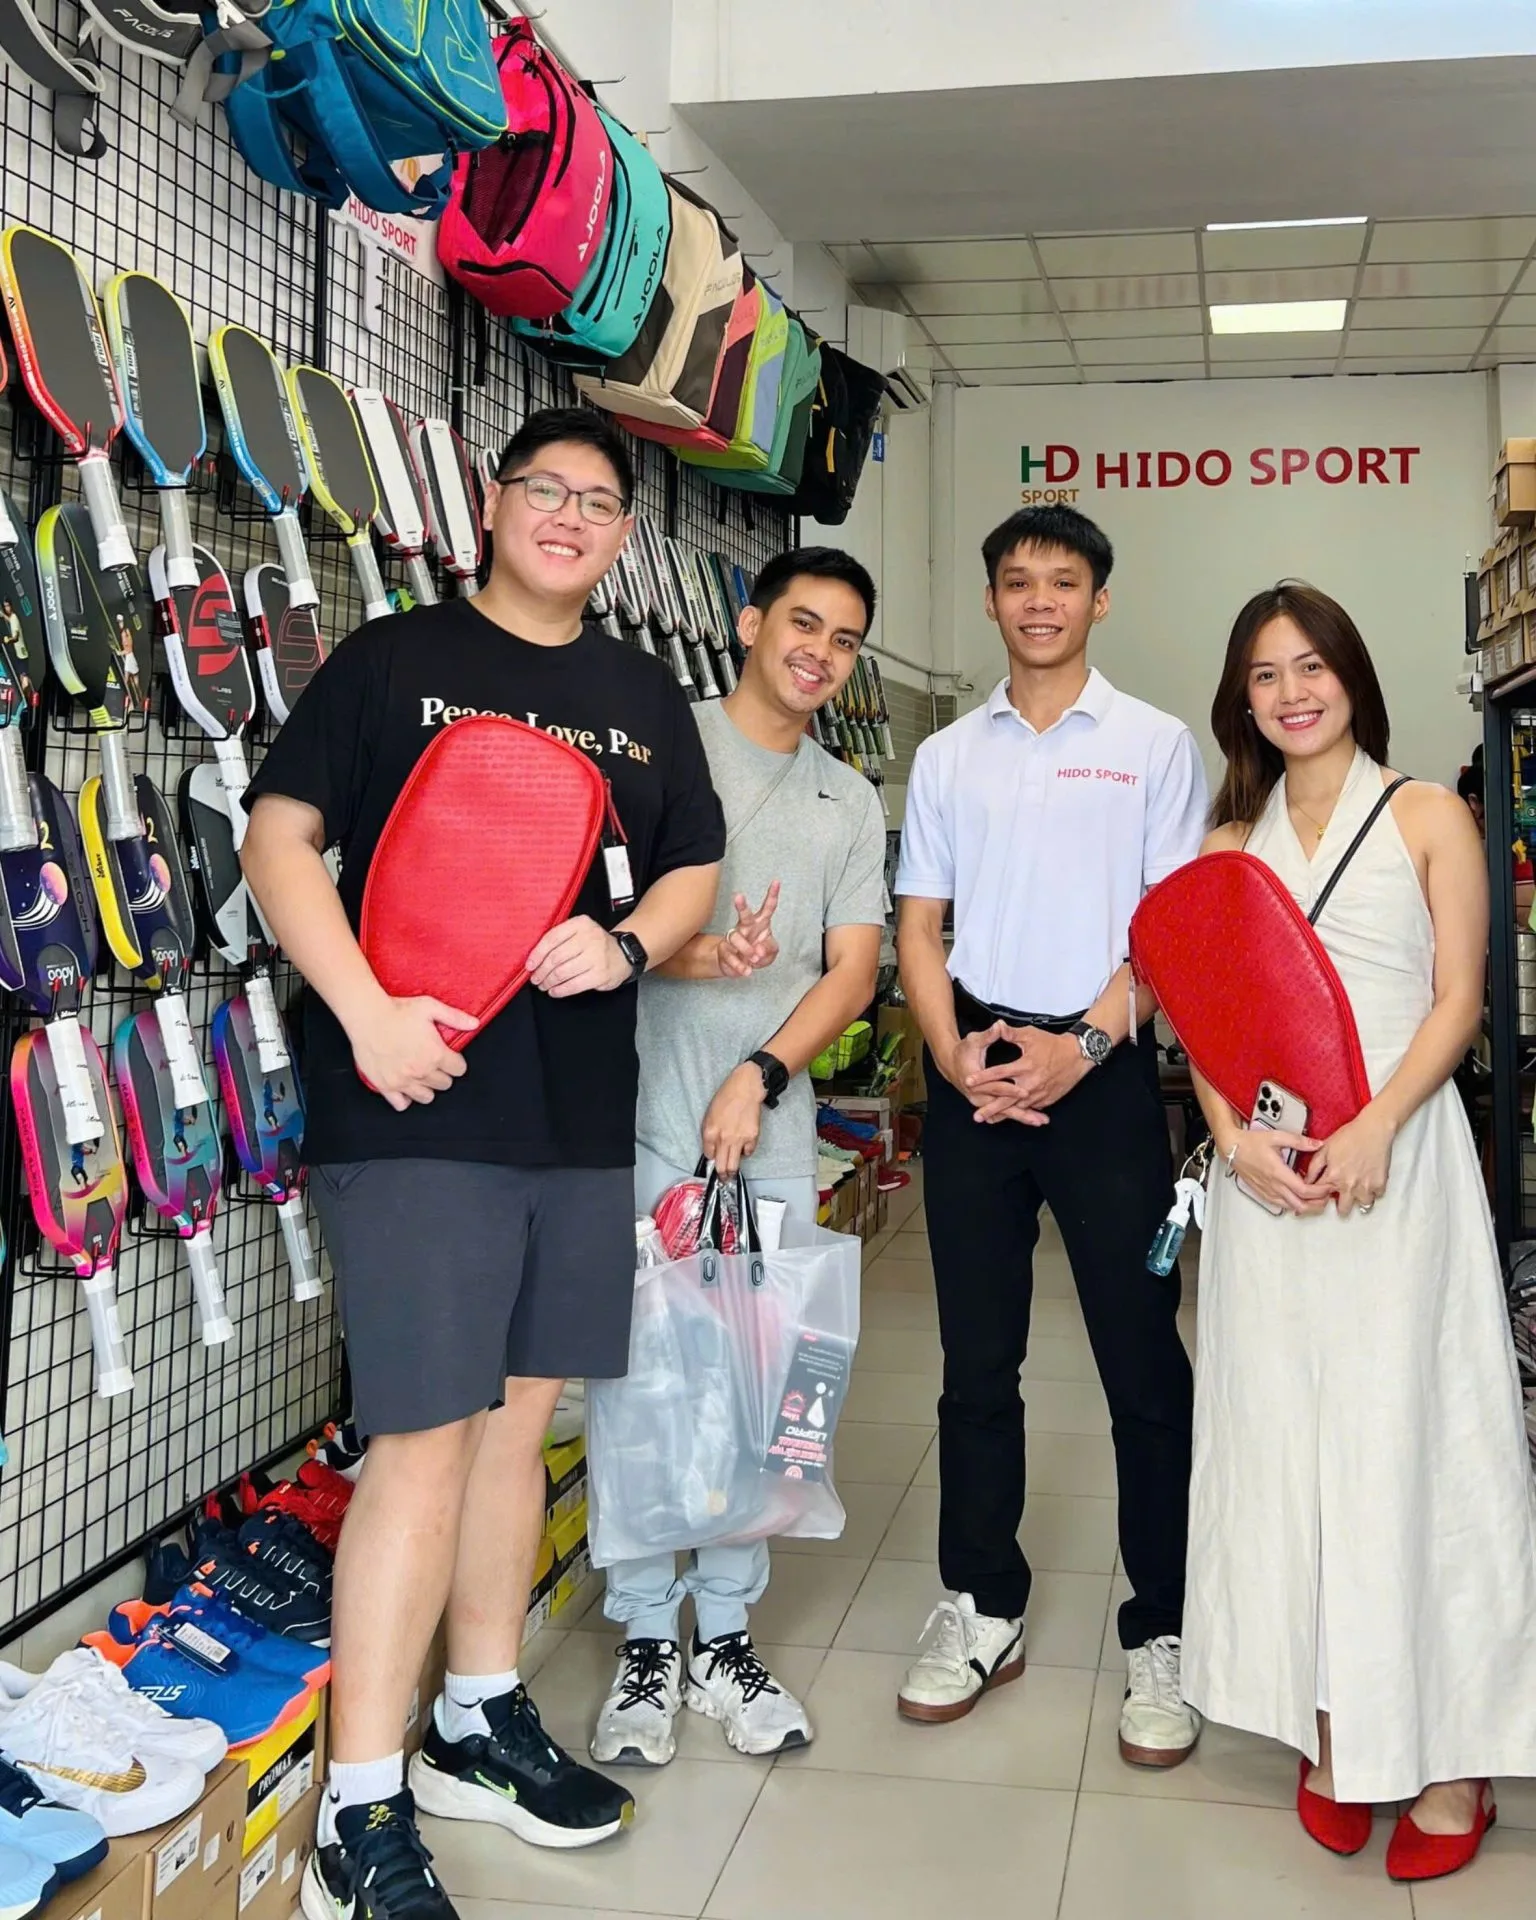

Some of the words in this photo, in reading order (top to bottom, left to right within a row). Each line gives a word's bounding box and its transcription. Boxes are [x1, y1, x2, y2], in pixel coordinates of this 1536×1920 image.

[585, 151, 606, 241] JOOLA
[349, 197, 379, 231] HIDO
[382, 217, 417, 256] SPORT
[639, 225, 664, 308] JOOLA
[1021, 445, 1080, 483] HD
[1096, 450, 1232, 489] HIDO
[1250, 446, 1421, 485] SPORT
[1021, 489, 1080, 504] SPORT
[44, 576, 56, 612] JOOLA
[608, 728, 652, 765] Par
[1057, 768, 1091, 779] HIDO
[1095, 768, 1139, 786] SPORT
[257, 1751, 293, 1797] PROMAX
